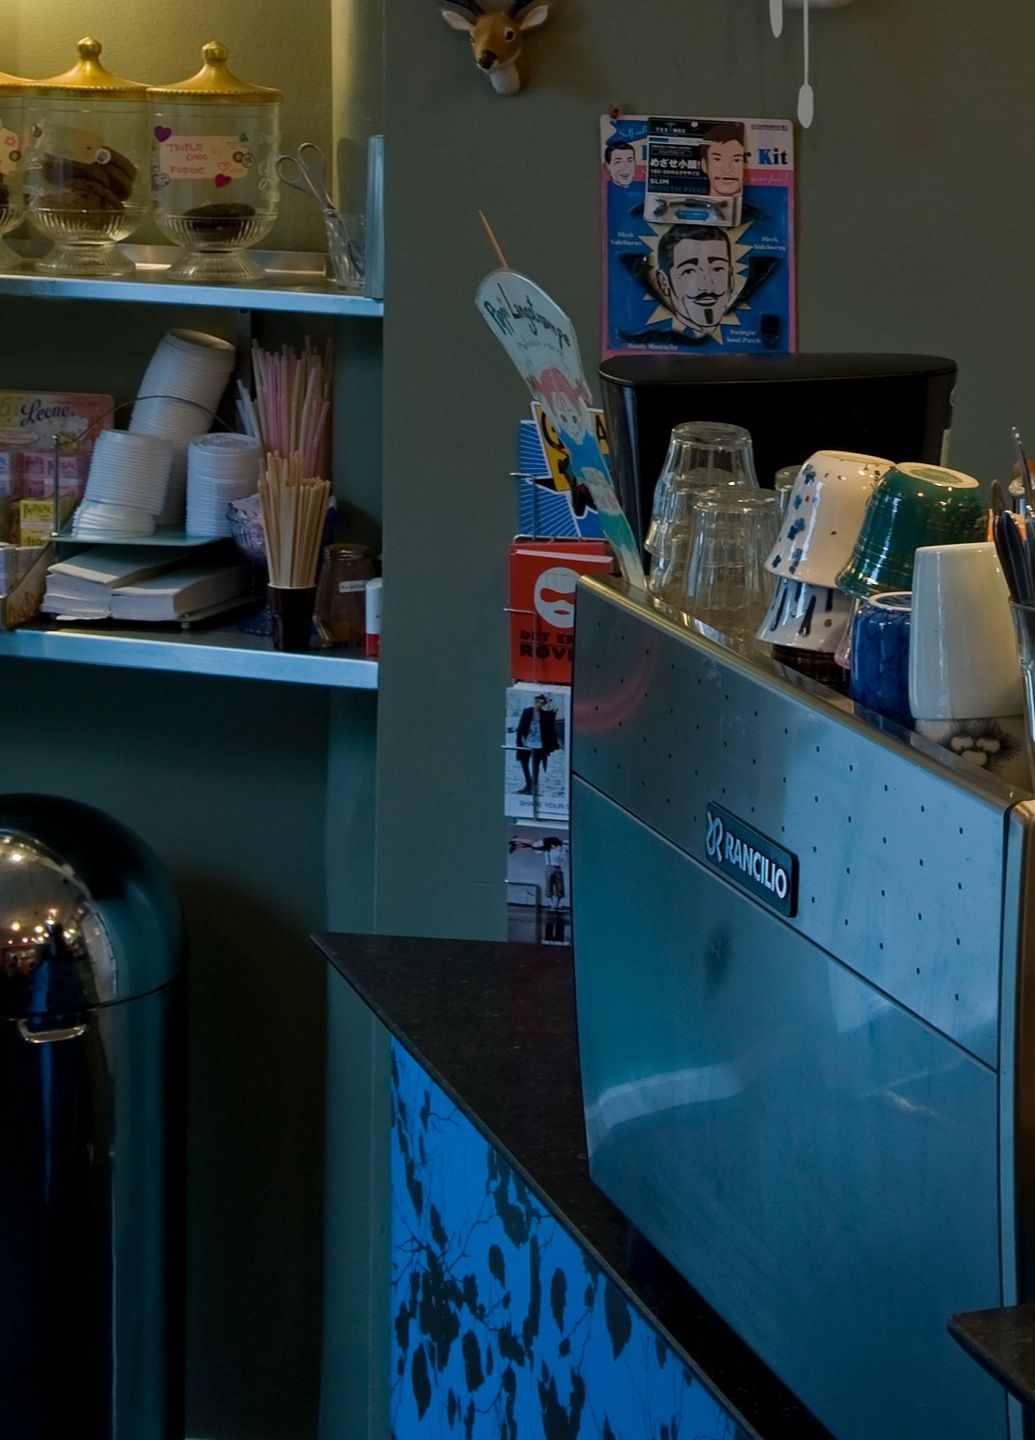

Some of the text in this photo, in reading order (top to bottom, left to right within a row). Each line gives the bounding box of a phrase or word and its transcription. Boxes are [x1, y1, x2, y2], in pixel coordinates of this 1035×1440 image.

[758, 148, 788, 165] Kit
[20, 399, 70, 427] Leone
[519, 630, 549, 642] DET
[724, 831, 788, 899] RANCILIO
